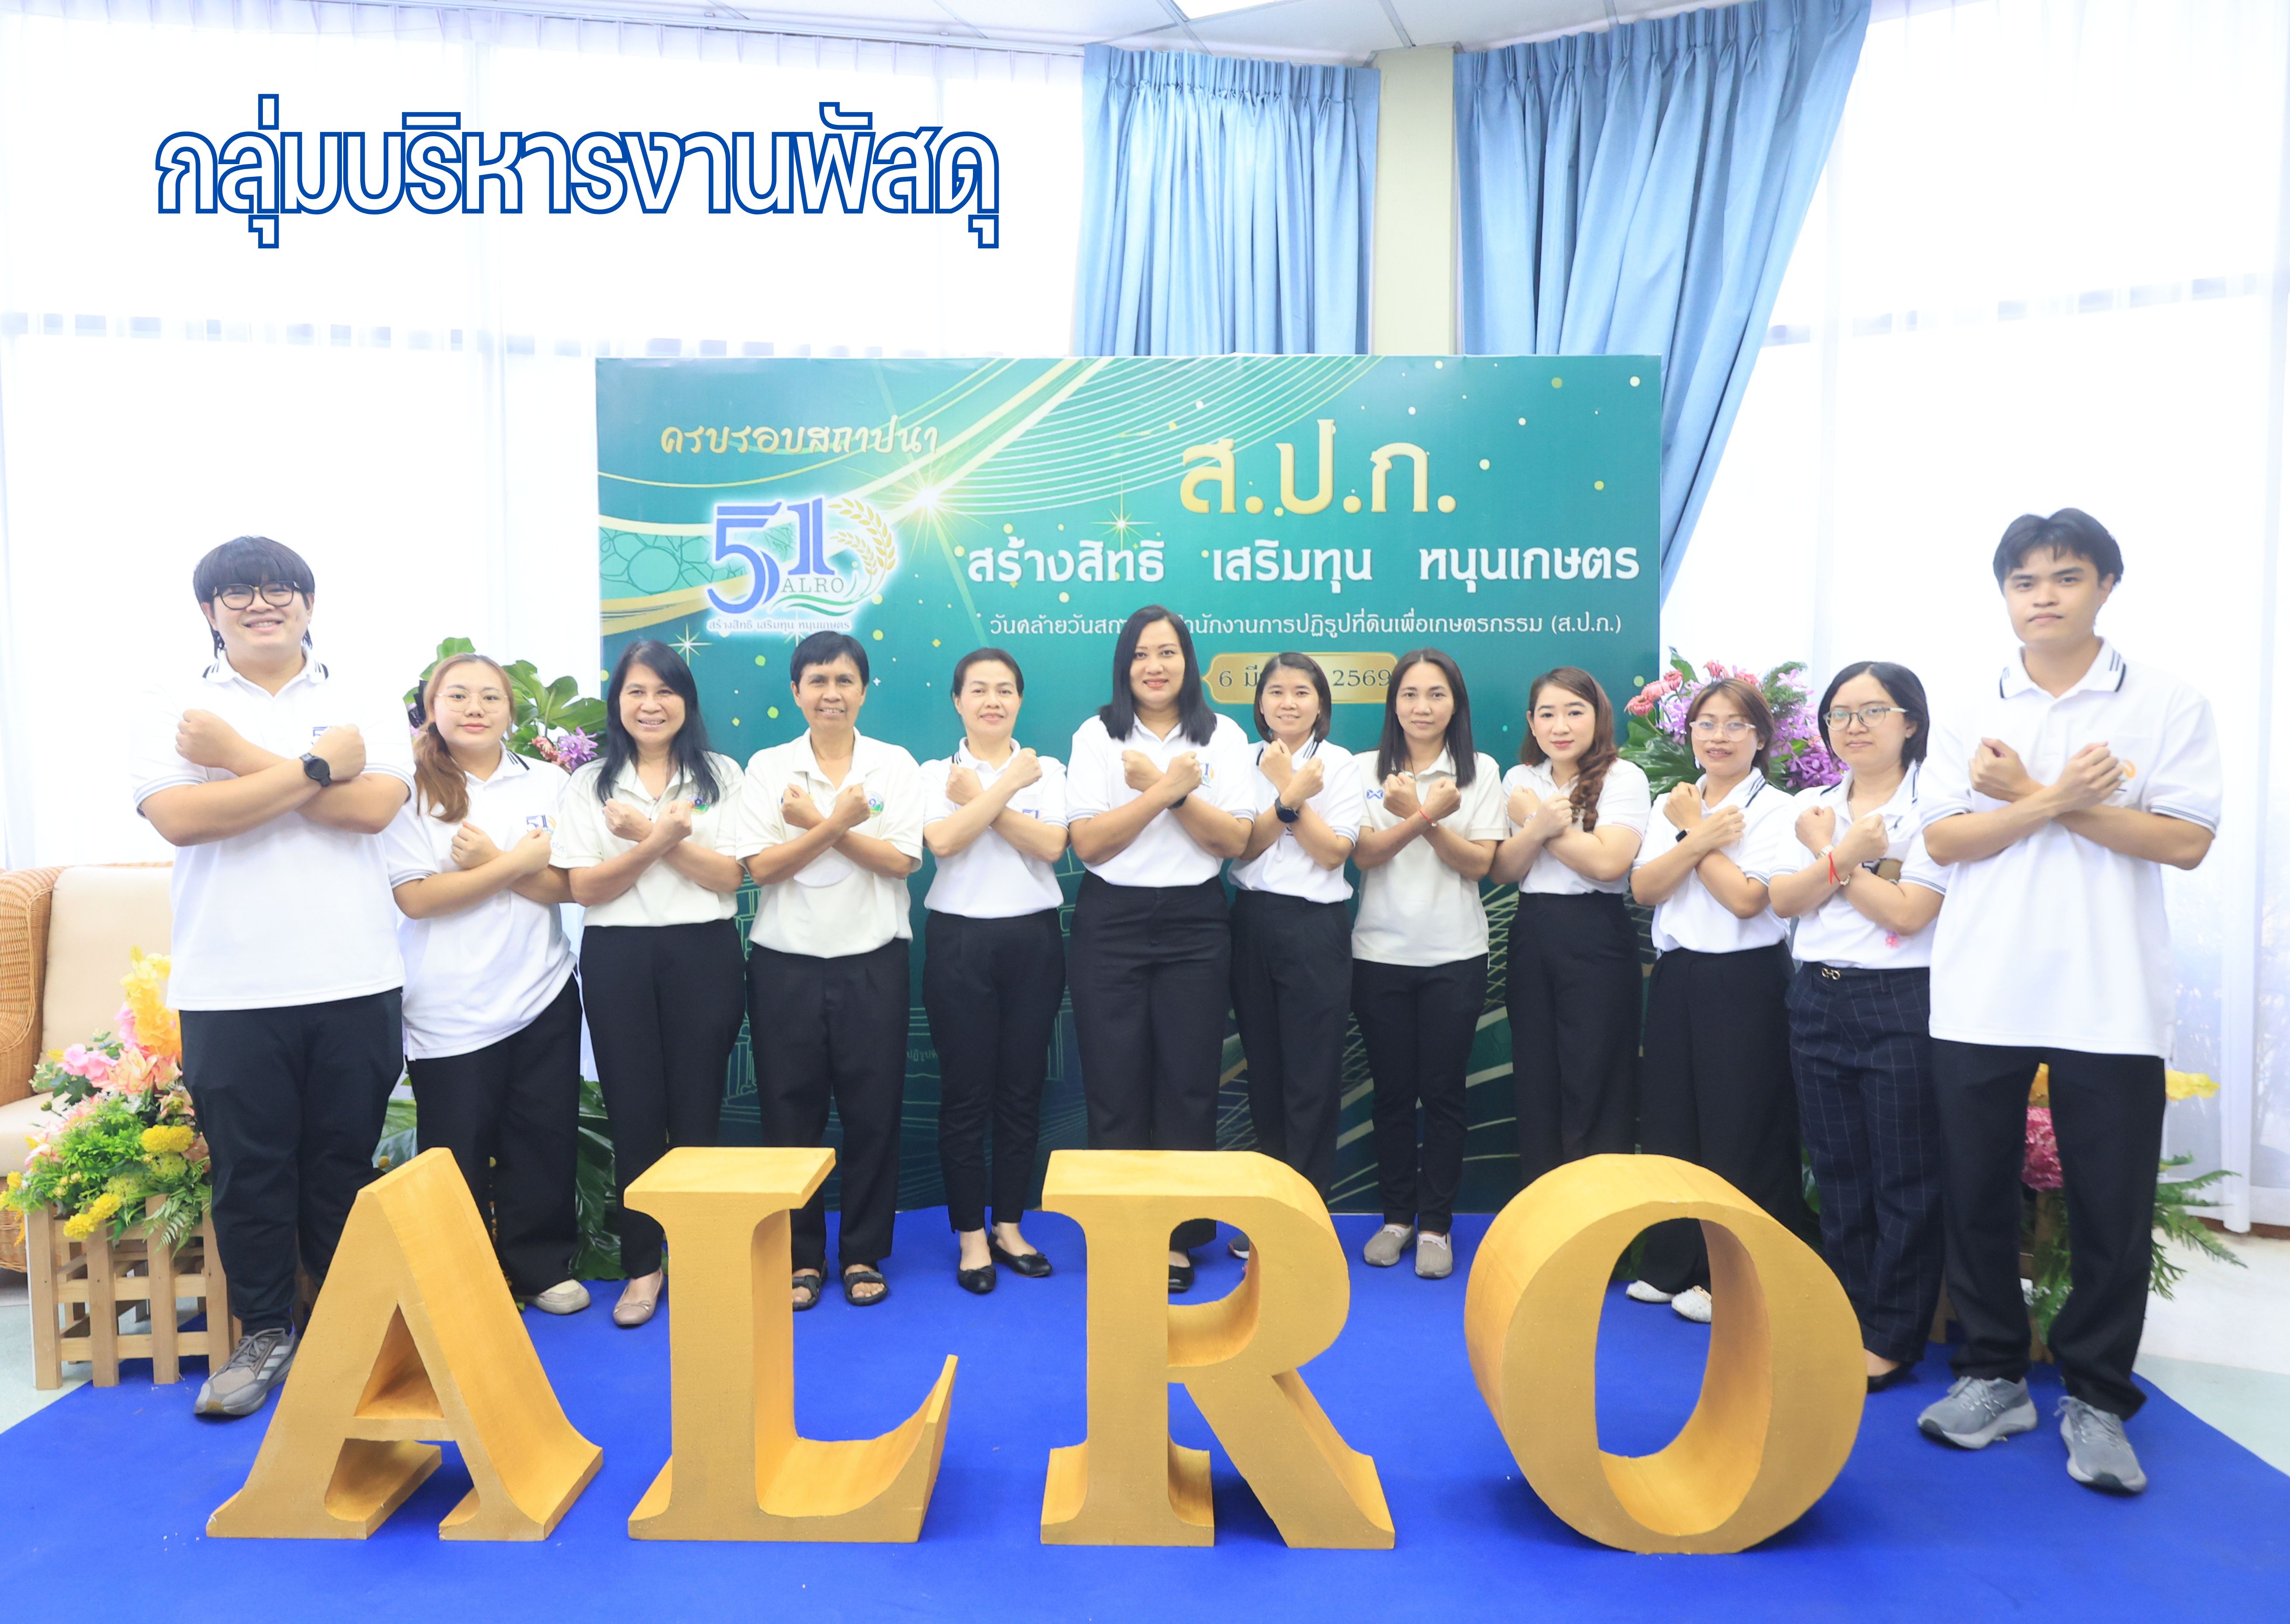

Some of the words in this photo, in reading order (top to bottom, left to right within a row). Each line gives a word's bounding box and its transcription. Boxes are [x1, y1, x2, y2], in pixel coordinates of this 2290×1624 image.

[661, 415, 937, 454] ครบรอบสถาปนา
[1180, 419, 1456, 514] ส.ป.ก.
[707, 498, 835, 614] 51
[968, 537, 1165, 582] สร้างสิทธิ
[1213, 539, 1373, 594] เสริมทุน
[1419, 546, 1640, 593] หนุนเกษตร
[780, 577, 845, 594] ALRO
[757, 620, 794, 631] เสริมทุน
[1551, 612, 1621, 634] (ส.ป.ก.)
[1219, 670, 1232, 687] 6
[1332, 669, 1391, 687] 2569
